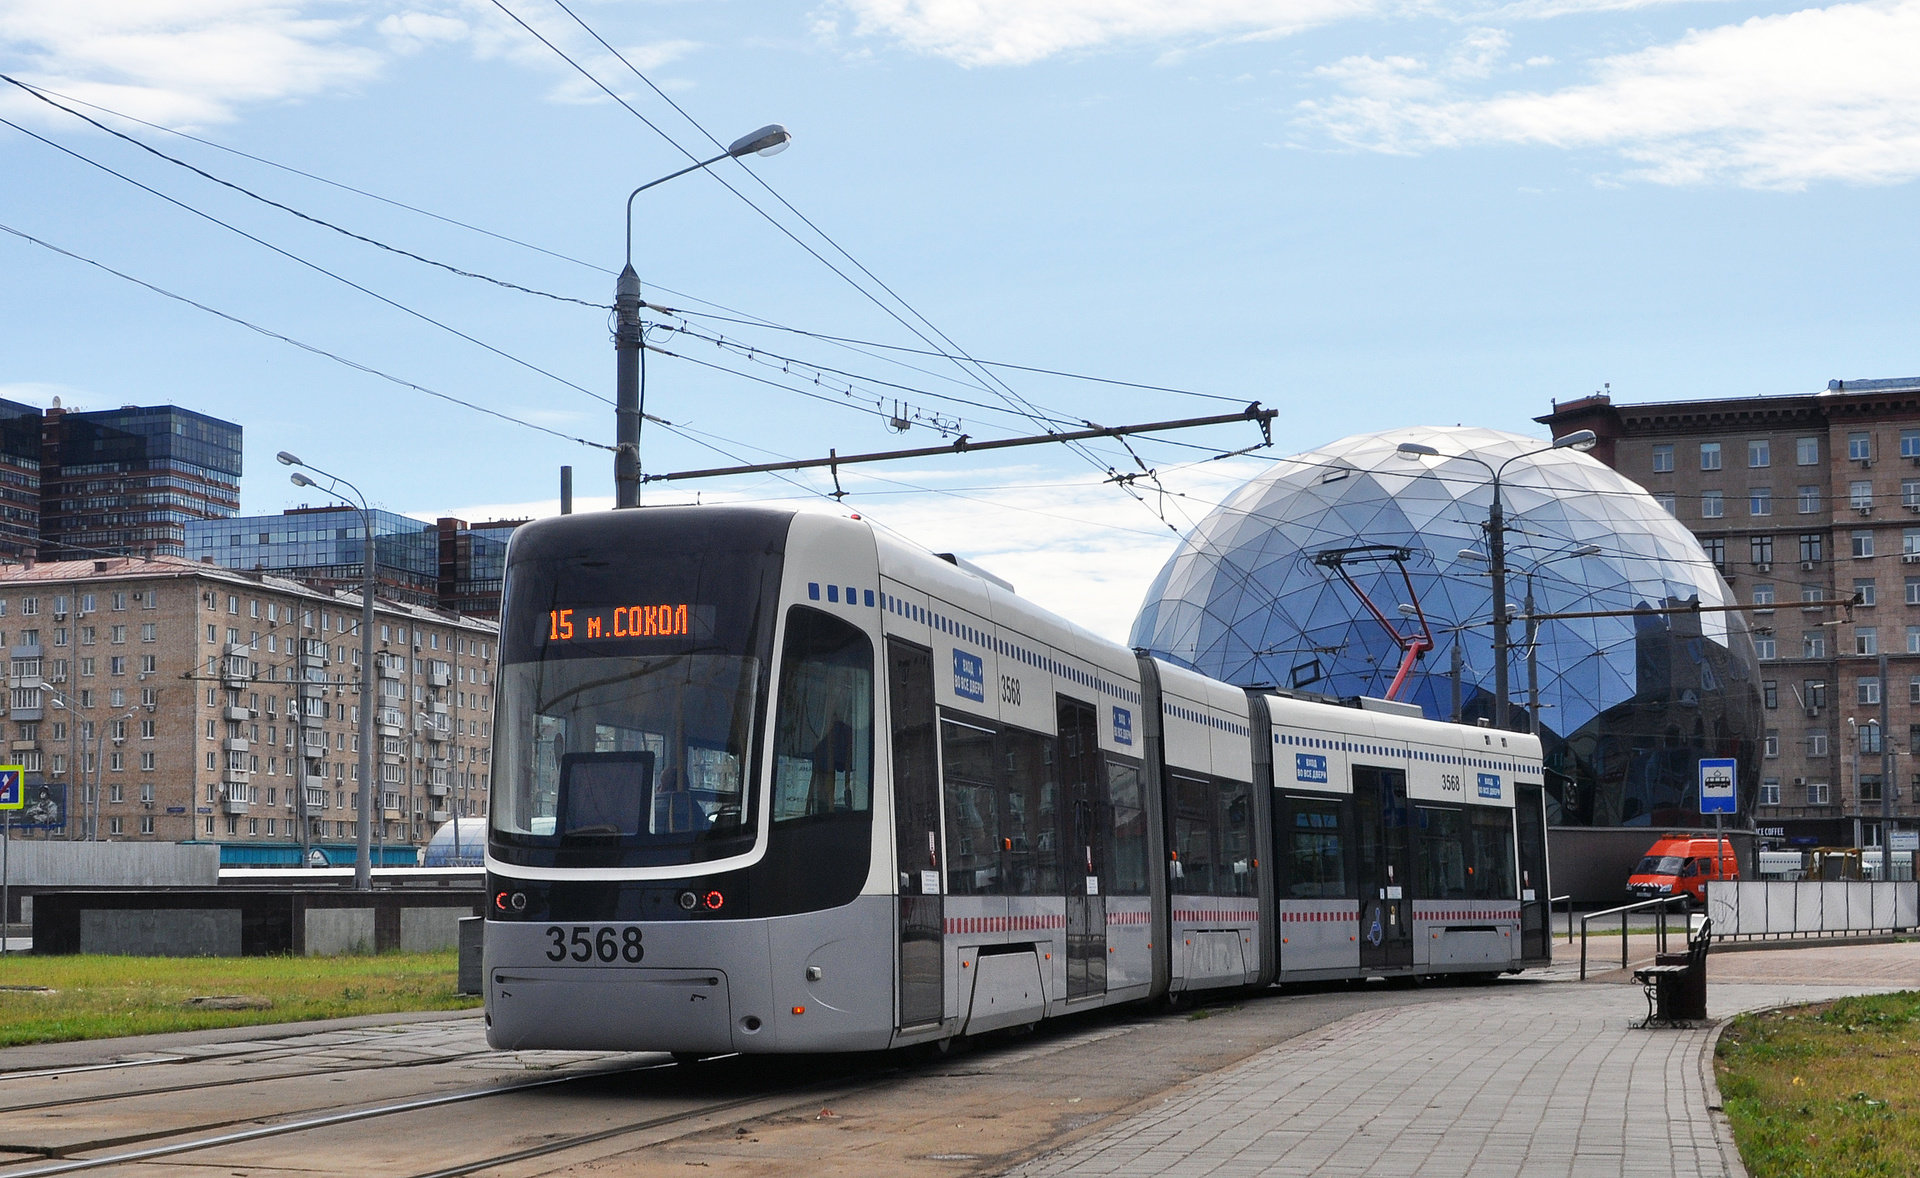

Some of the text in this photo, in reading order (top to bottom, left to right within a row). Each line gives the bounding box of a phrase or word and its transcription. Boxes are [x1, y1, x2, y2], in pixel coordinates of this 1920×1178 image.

[550, 609, 573, 640] 15
[962, 658, 974, 677] ВХОД
[954, 674, 983, 696] ВО ВСЕ ДВЕРИ
[1001, 674, 1021, 706] 3568
[1306, 758, 1317, 768] ВХОД
[1298, 768, 1326, 780] ВО ВСЕ ДВЕРИ
[1441, 774, 1460, 791] 3568
[1764, 827, 1785, 836] COFFEE
[546, 926, 645, 963] 3568
